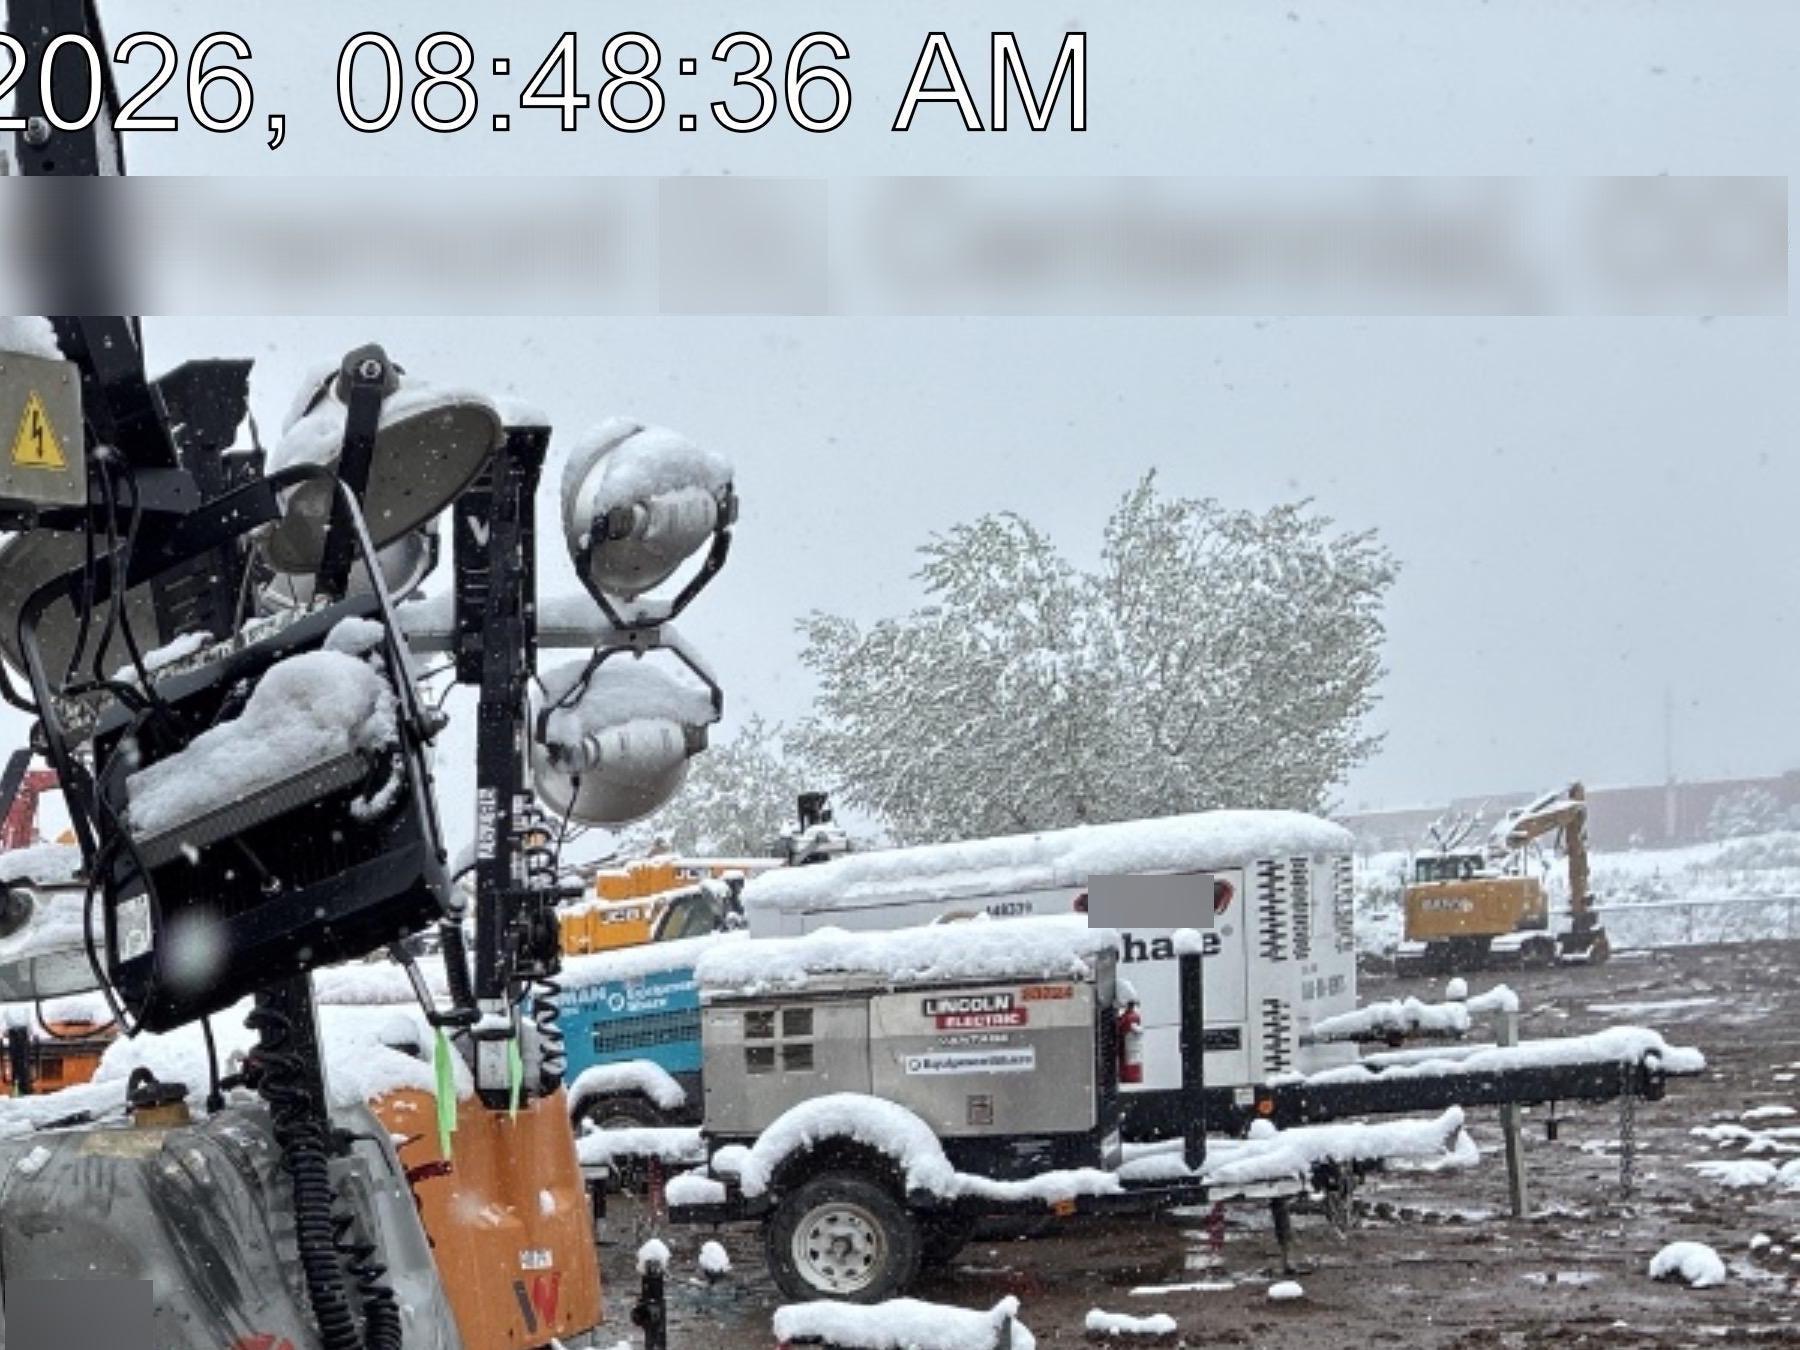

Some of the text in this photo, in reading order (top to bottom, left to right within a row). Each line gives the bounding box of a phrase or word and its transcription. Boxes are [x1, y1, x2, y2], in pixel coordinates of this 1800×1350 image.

[1114, 931, 1222, 964] hae
[925, 993, 1011, 1015] LINCOLN
[944, 1011, 1022, 1028] ELECTRIC
